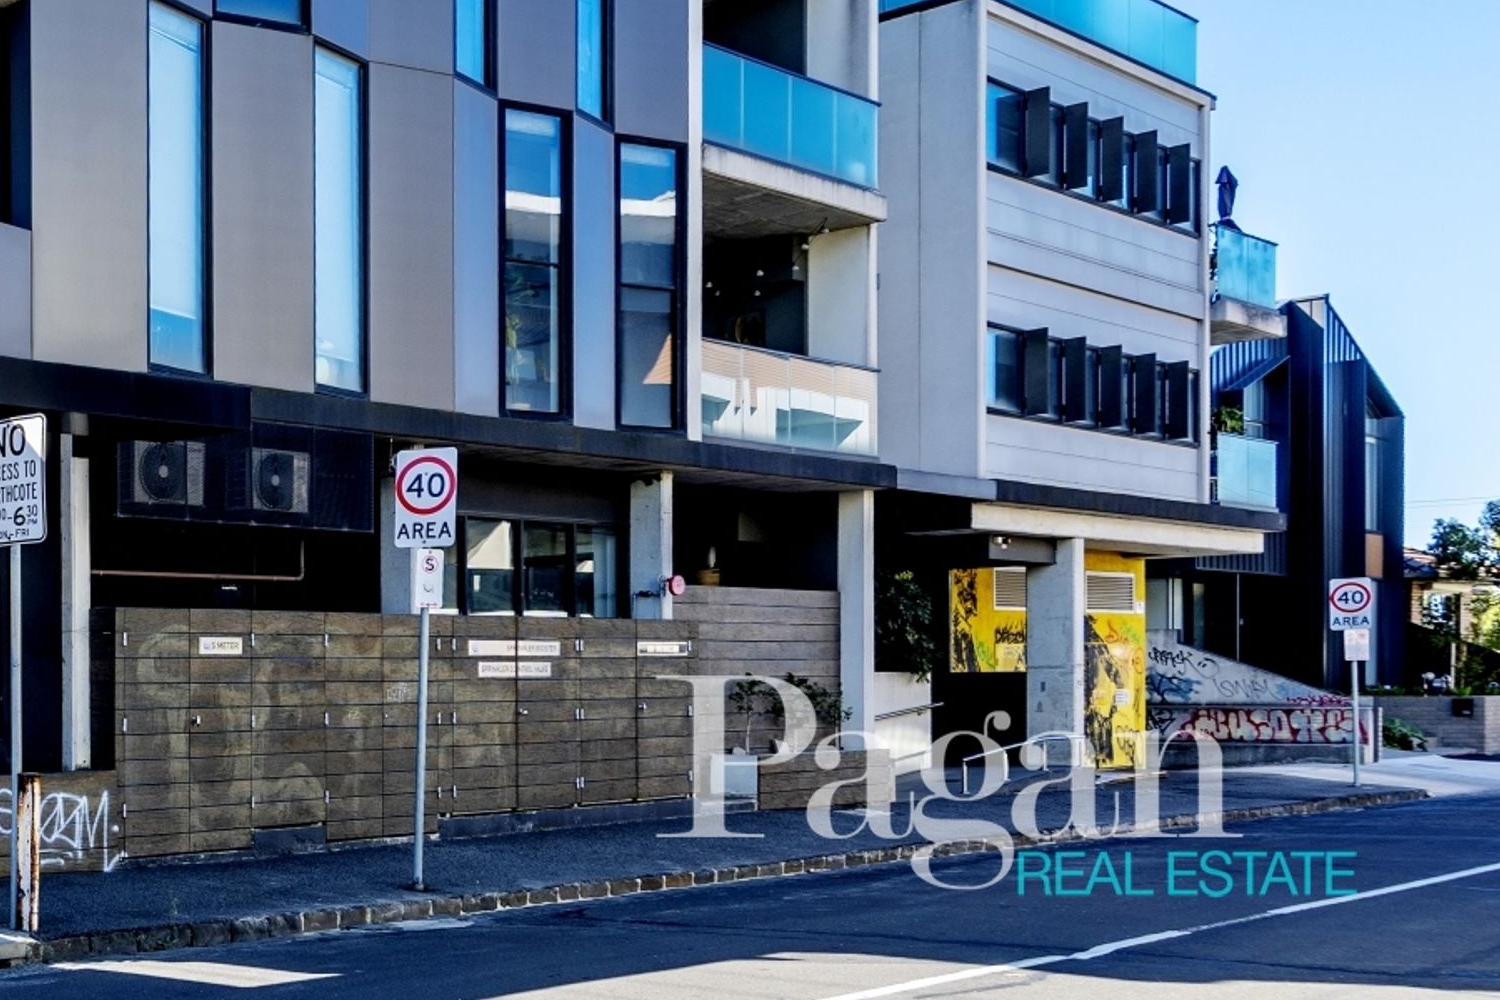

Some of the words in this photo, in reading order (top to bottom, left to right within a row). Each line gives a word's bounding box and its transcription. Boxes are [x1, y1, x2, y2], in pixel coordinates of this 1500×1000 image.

[24, 459, 36, 478] TO
[406, 472, 445, 498] 40
[397, 521, 452, 540] AREA
[1337, 590, 1364, 605] 40
[1332, 615, 1370, 626] AREA
